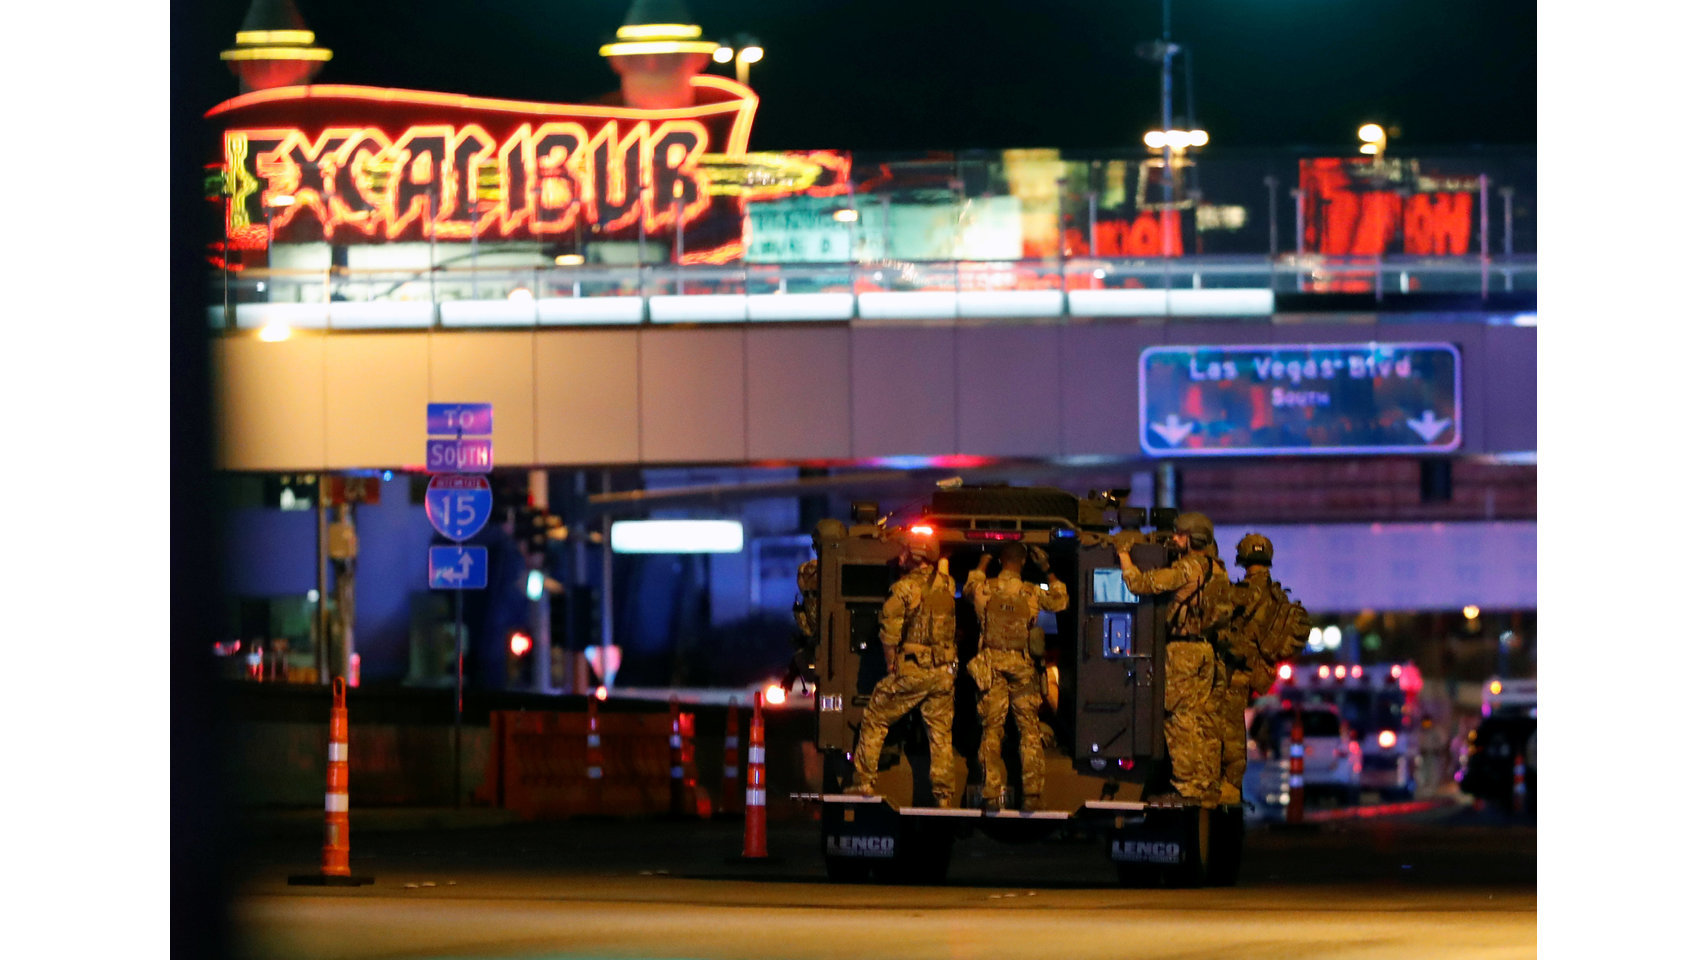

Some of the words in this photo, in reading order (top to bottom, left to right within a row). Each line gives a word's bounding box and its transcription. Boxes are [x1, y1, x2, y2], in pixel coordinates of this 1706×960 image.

[225, 121, 711, 239] EXCALIBUR
[1190, 357, 1237, 380] Las
[1254, 357, 1334, 385] Vegas
[1348, 357, 1411, 380] Blvd
[444, 410, 474, 428] TO
[436, 478, 481, 489] INTETATE
[442, 495, 476, 527] 15
[826, 835, 895, 850] LENCO
[1111, 840, 1180, 856] LENCO
